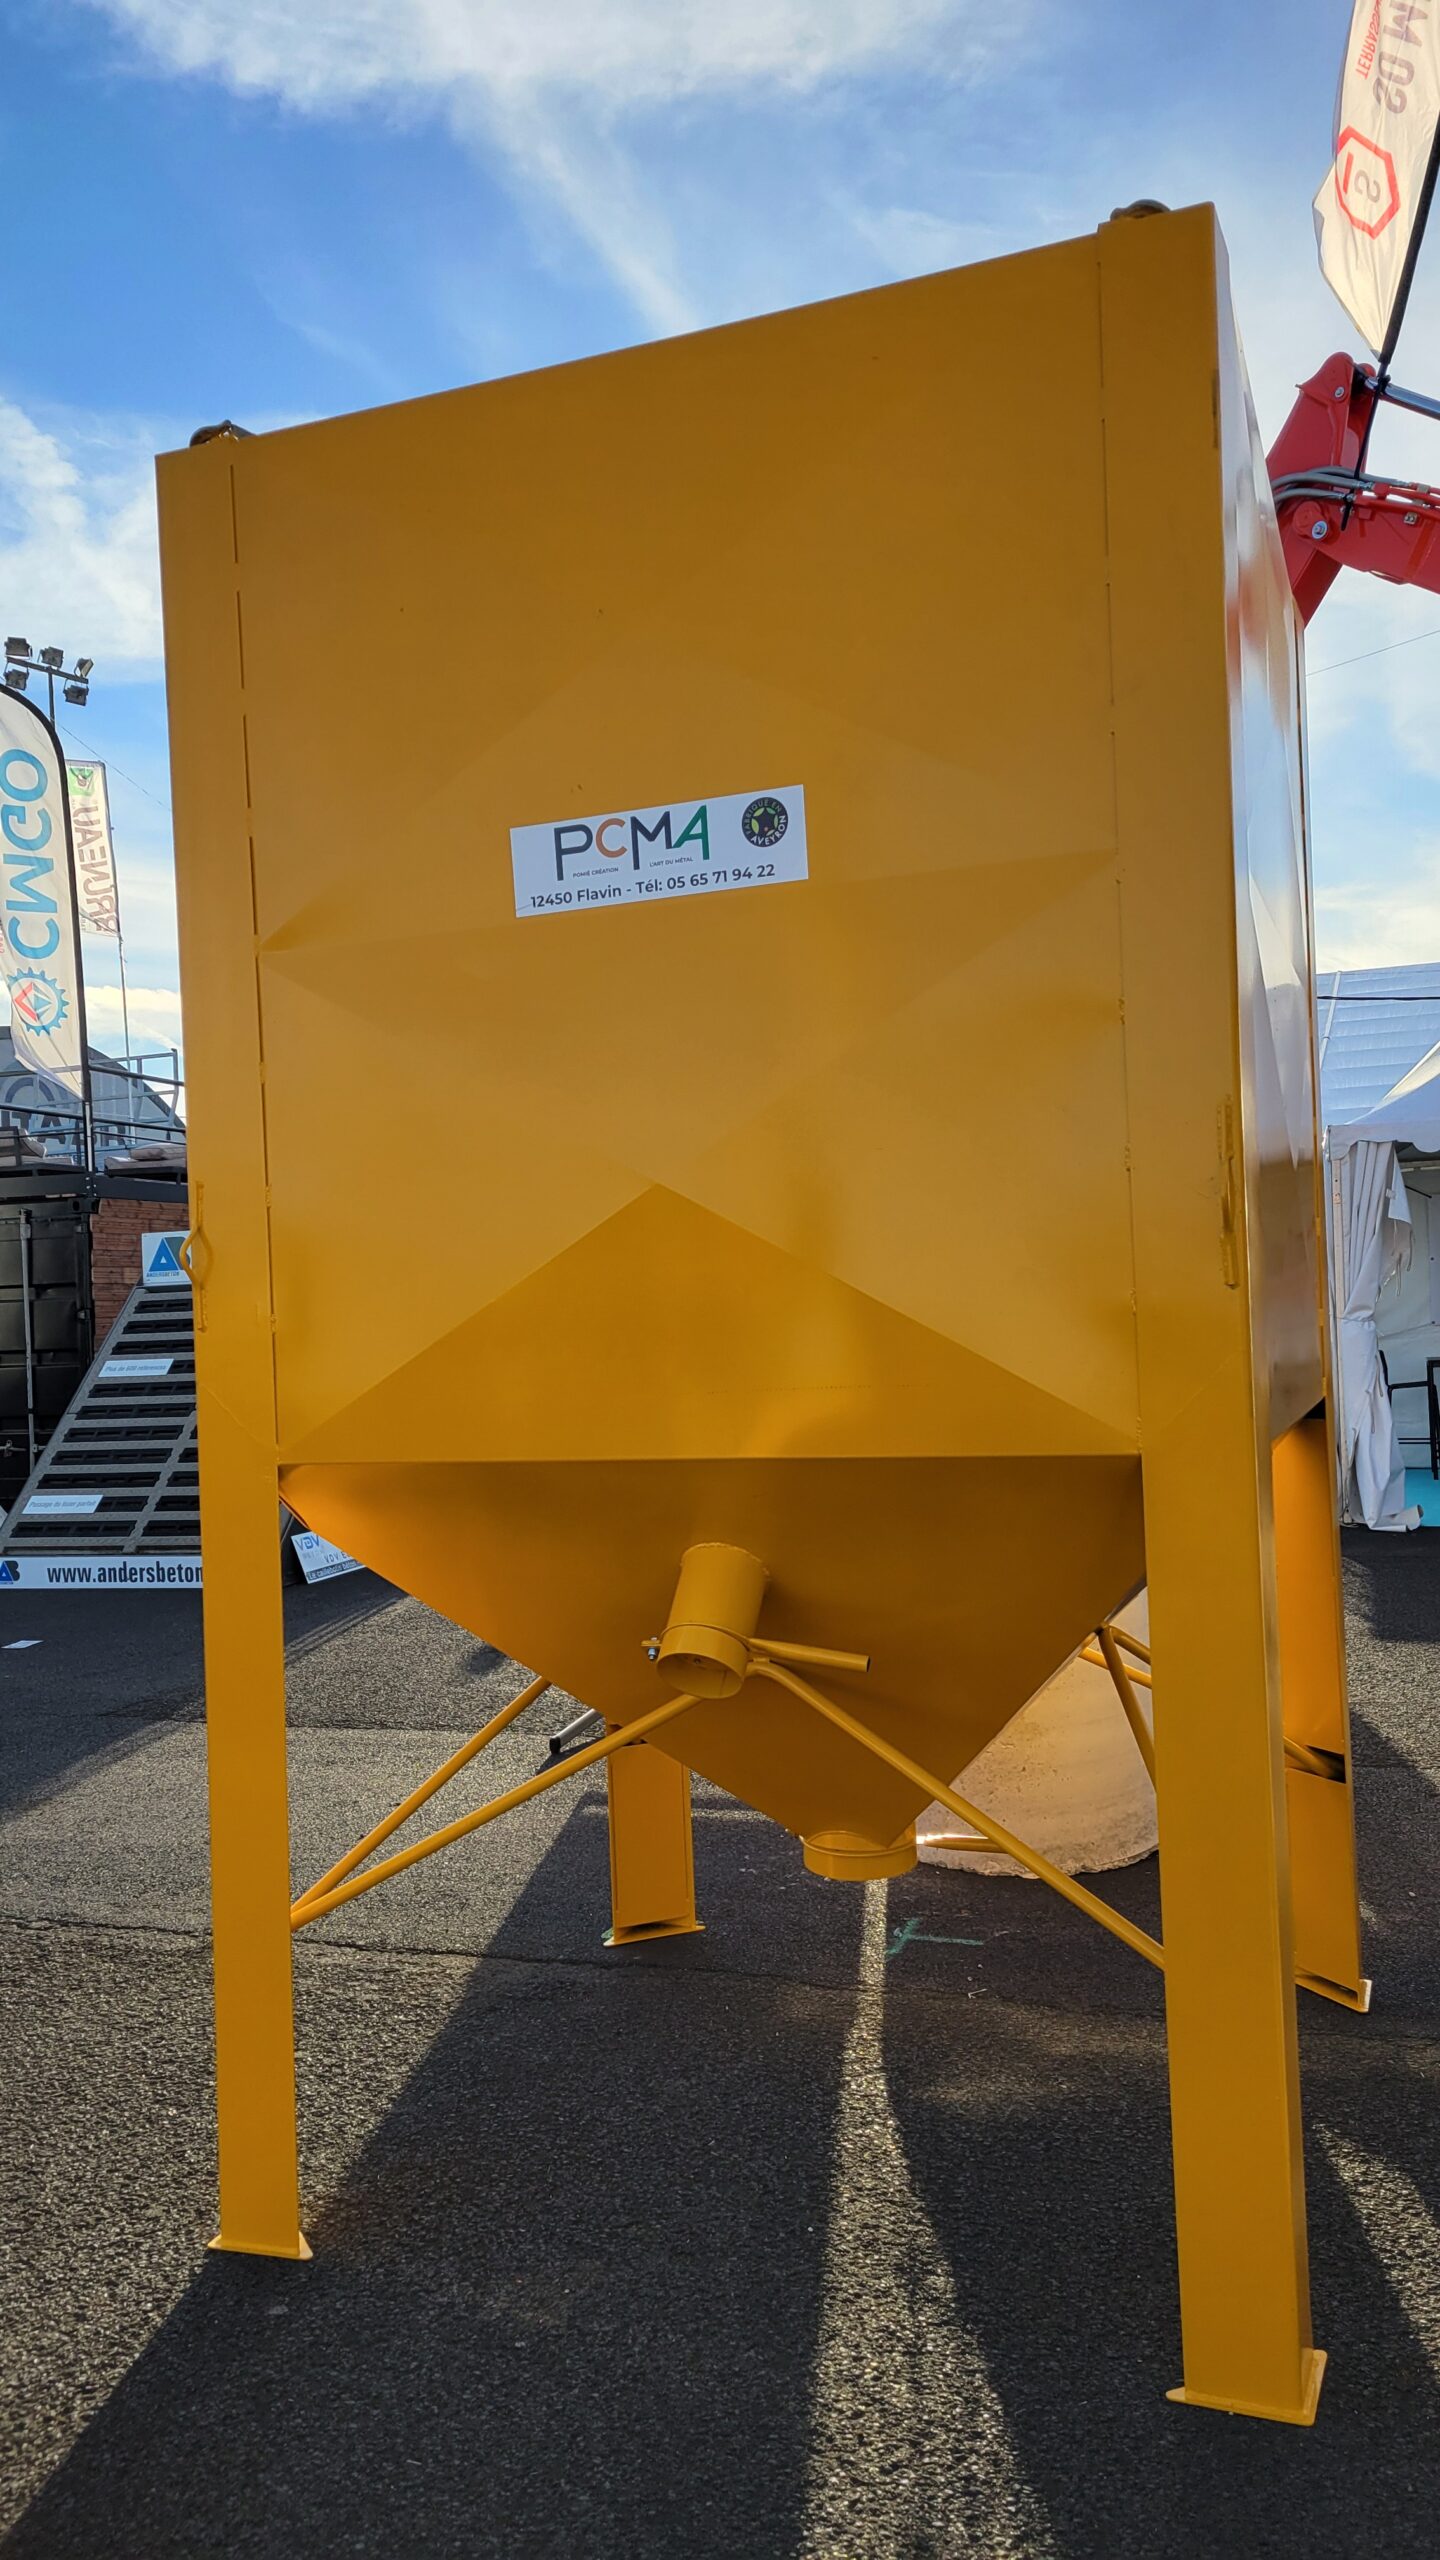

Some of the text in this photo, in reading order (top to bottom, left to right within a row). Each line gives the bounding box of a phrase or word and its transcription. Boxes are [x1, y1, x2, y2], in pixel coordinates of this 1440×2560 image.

[553, 804, 710, 882] PCMA
[750, 815, 787, 845] AVEYRON
[591, 867, 619, 875] CRÉATION
[674, 856, 694, 864] MÉTAL
[531, 891, 573, 909] 12450
[577, 884, 622, 903] Flavin
[636, 876, 663, 895] Tél:
[667, 876, 686, 890] 05
[690, 872, 709, 886] 65
[712, 869, 728, 884] 71
[732, 866, 753, 881] 94
[757, 863, 776, 878] 22
